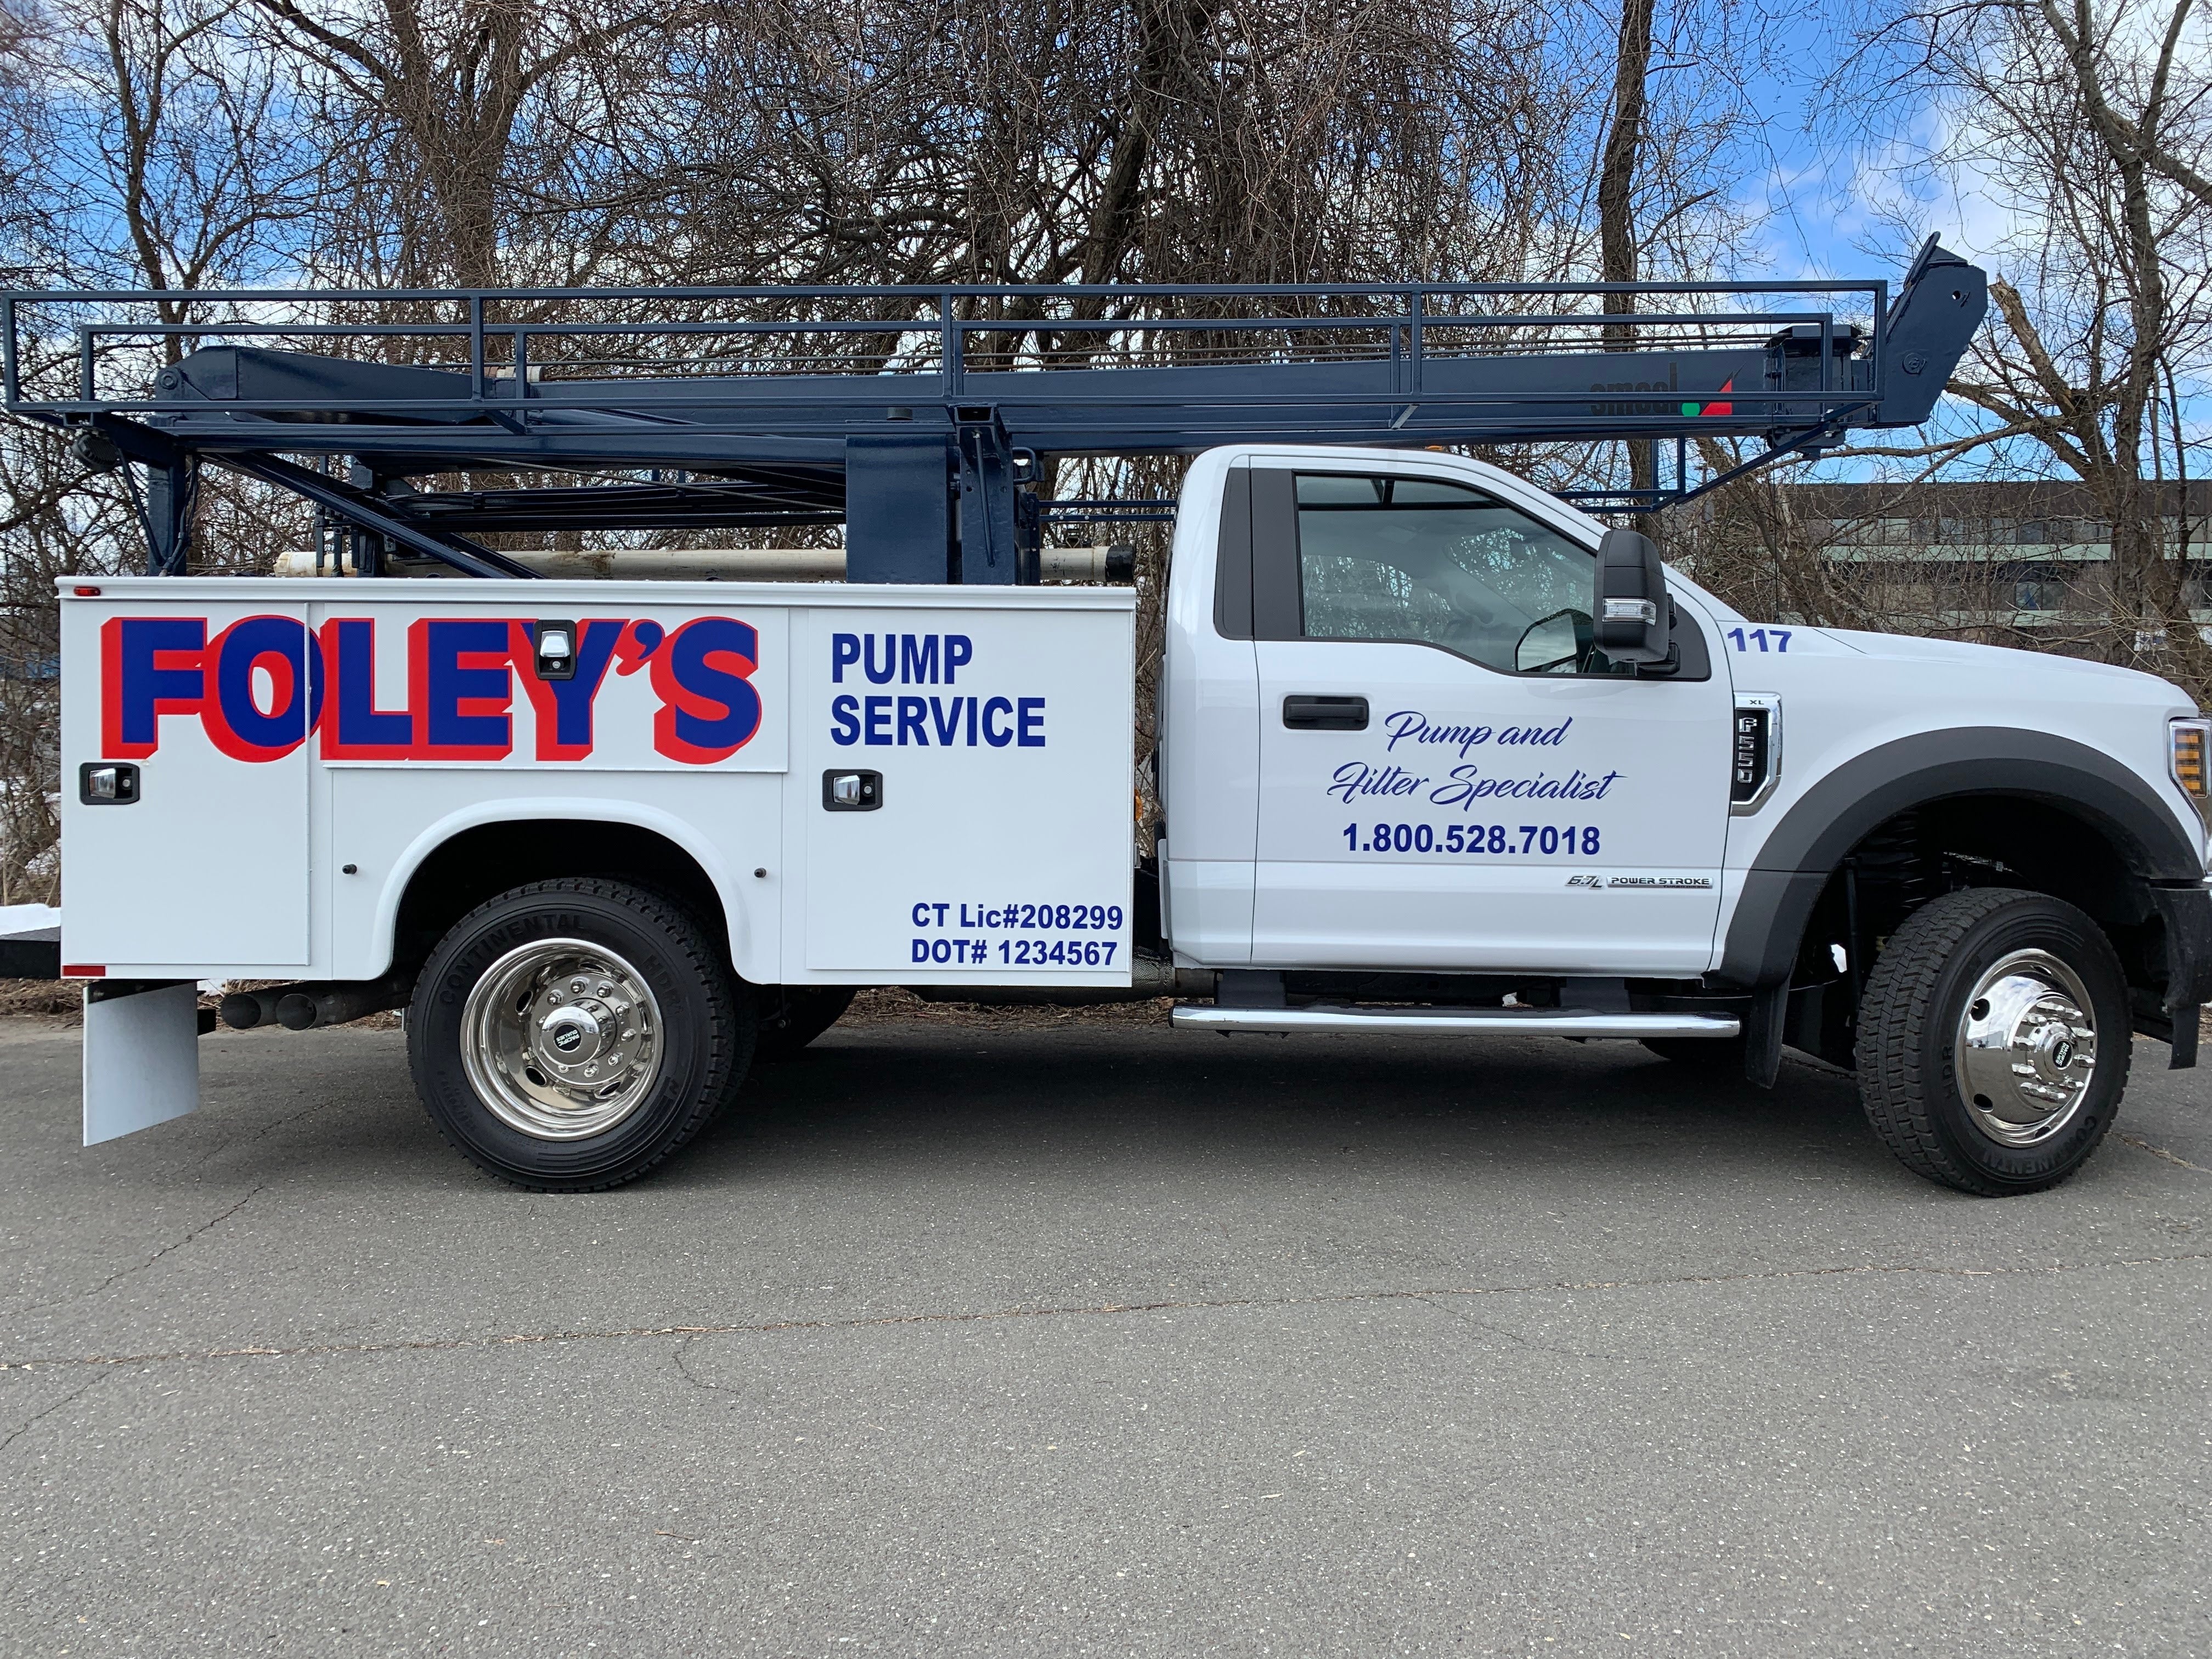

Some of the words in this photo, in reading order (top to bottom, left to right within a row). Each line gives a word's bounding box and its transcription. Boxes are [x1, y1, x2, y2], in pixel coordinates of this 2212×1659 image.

[832, 633, 973, 685] PUMP
[1727, 628, 1792, 653] 117
[101, 614, 762, 765] FOLEY'S
[830, 695, 1046, 748] SERVICE
[1384, 710, 1496, 759] Pump
[1497, 716, 1573, 746] and
[1327, 761, 1430, 804] Filter
[1429, 764, 1628, 812] Specialist
[1343, 823, 1600, 855] 1.800.528.7018
[912, 902, 950, 927] CT
[960, 904, 1123, 930] Lic#208299
[438, 912, 586, 1004] CONTINENTAL
[912, 939, 988, 964] DOT#
[998, 939, 1118, 966] 1234567
[557, 1034, 580, 1047] PACIFIC
